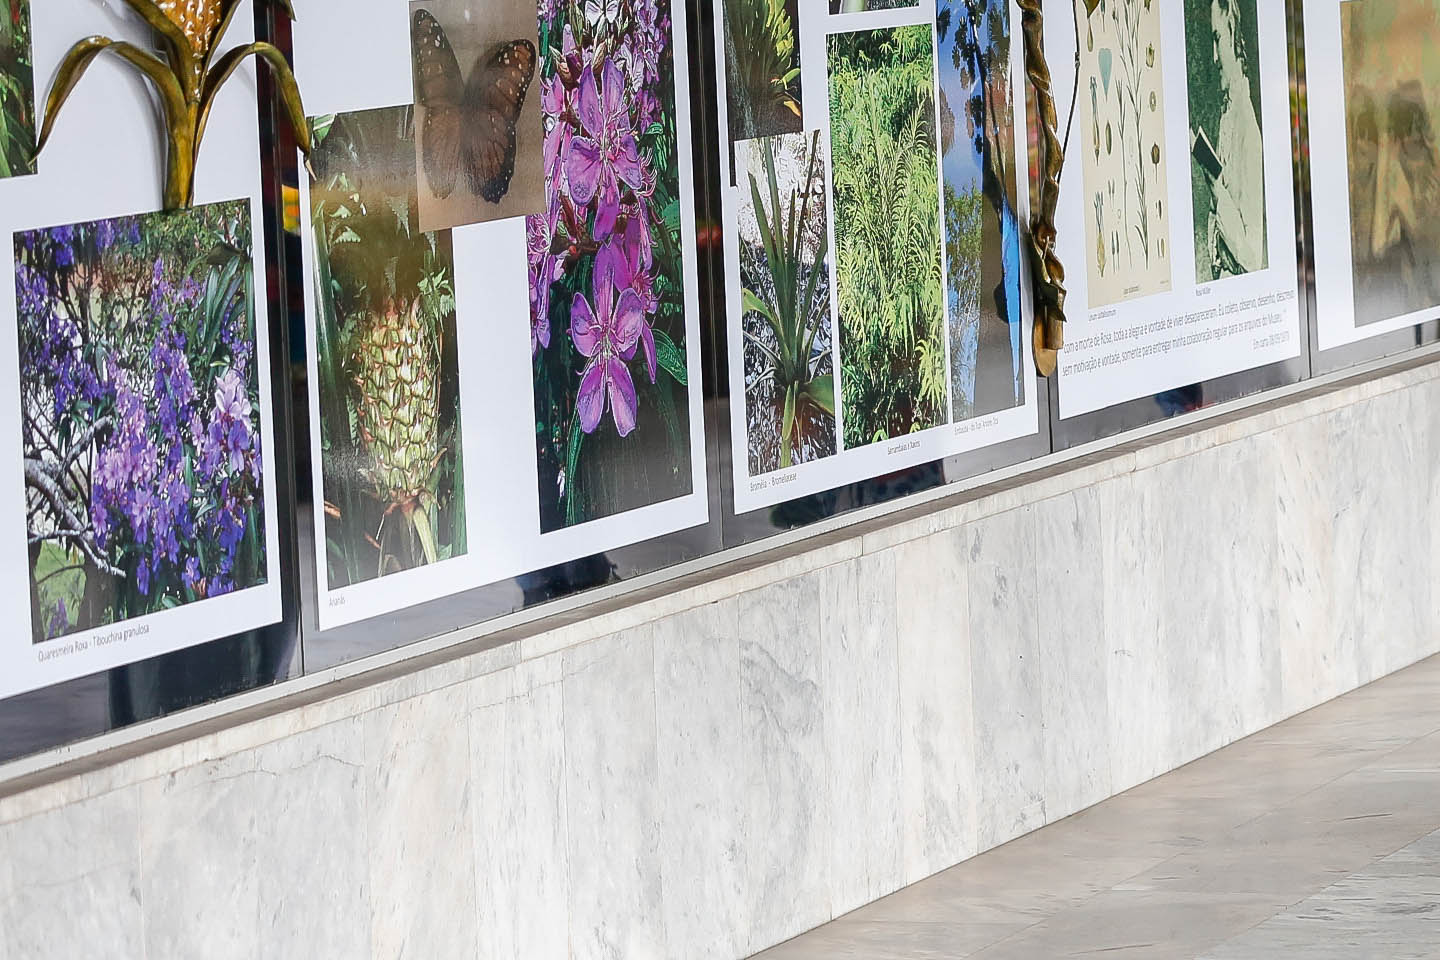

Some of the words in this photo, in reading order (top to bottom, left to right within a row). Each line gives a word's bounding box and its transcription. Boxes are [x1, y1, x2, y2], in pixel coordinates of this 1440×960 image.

[39, 644, 74, 662] Quaresmeira
[75, 641, 88, 651] Roxa
[93, 632, 122, 647] Tibouchina
[124, 624, 150, 642] granulosa
